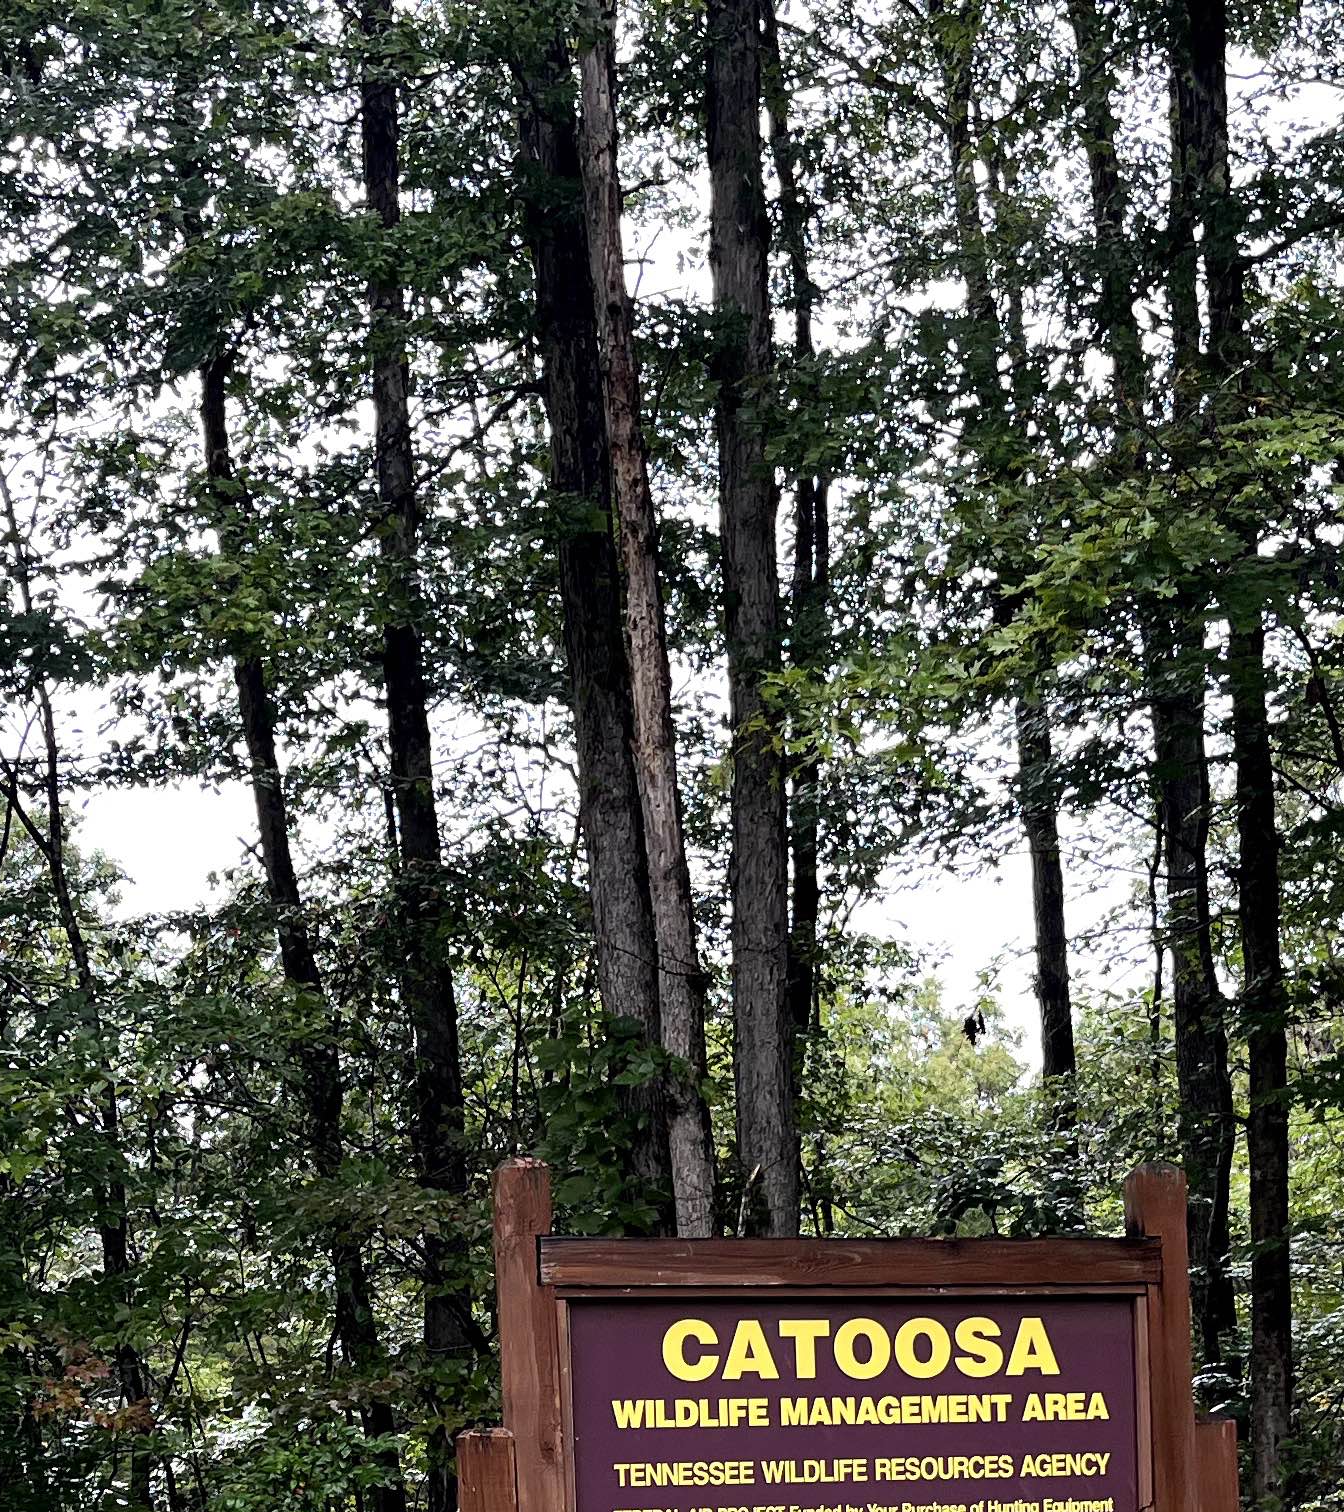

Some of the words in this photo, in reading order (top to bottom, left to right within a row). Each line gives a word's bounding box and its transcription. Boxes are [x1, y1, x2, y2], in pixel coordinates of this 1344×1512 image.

[662, 1317, 1060, 1381] CATOOSA
[612, 1398, 768, 1428] WILDLIFE
[781, 1395, 1011, 1425] MANAGEMENT
[1022, 1393, 1108, 1422] AREA
[615, 1462, 754, 1487] TENNESSEE
[761, 1458, 867, 1483] WILDLIFE
[875, 1455, 1013, 1481] RESOURCES
[1020, 1453, 1110, 1478] AGENCY
